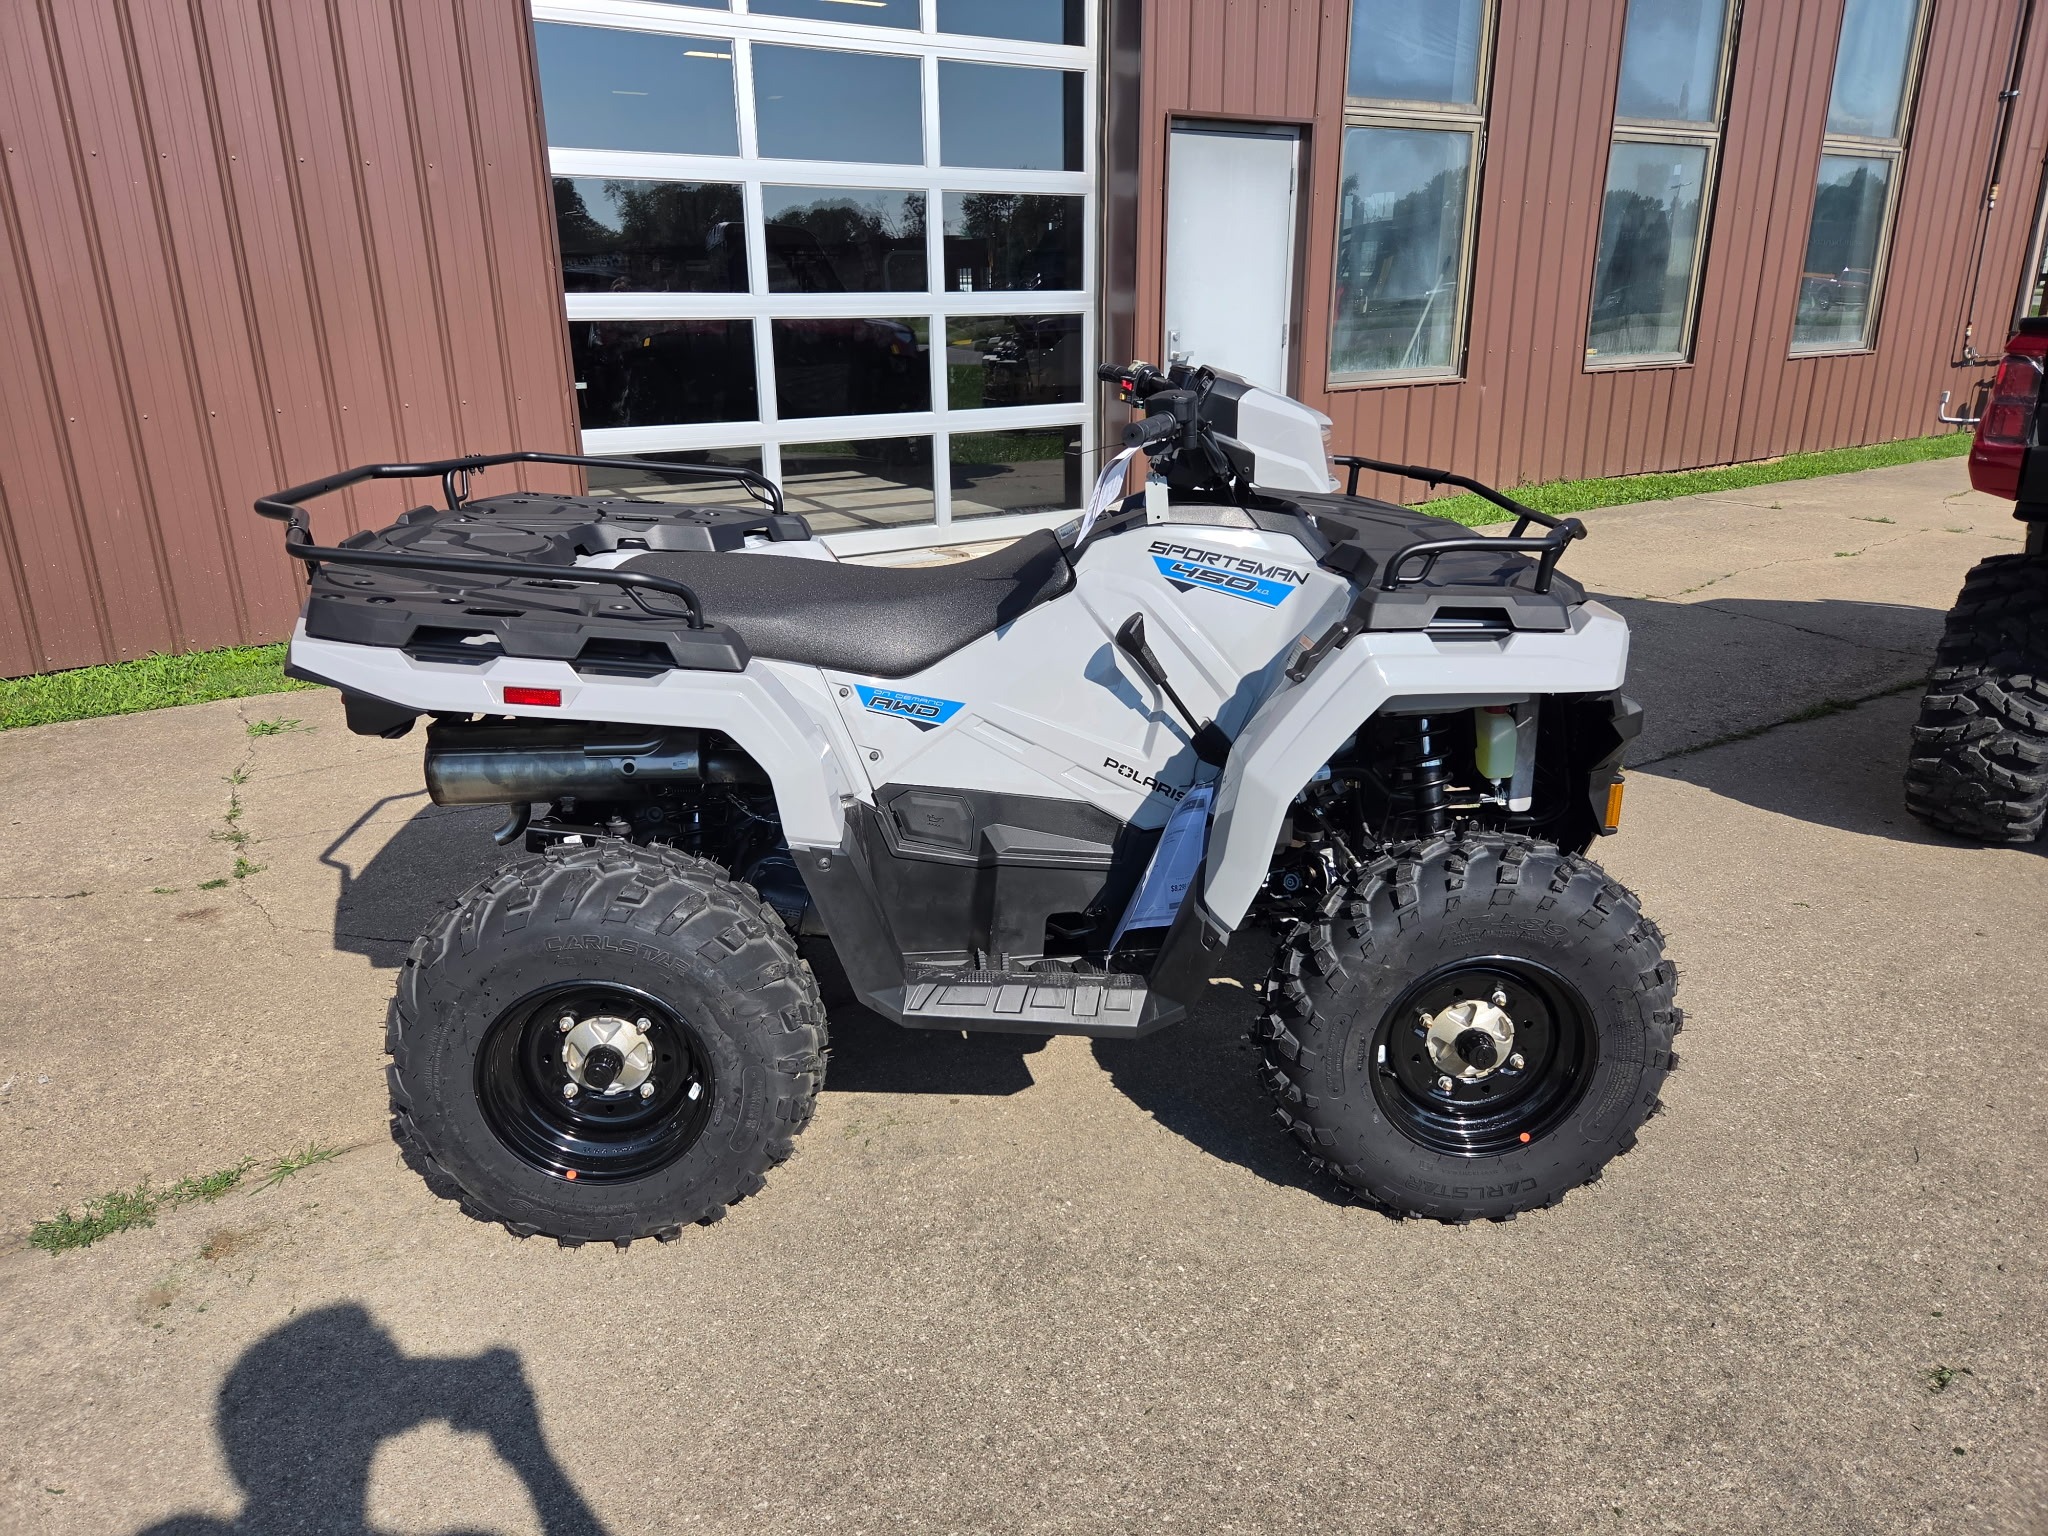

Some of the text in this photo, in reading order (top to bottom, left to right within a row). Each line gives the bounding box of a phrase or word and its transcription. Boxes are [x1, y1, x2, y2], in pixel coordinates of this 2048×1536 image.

[1148, 541, 1310, 585] SPORTSMAN
[1170, 562, 1259, 593] 450
[868, 696, 941, 717] AWD
[873, 689, 944, 707] ON DEMAND
[1103, 757, 1187, 802] POLARIS
[544, 934, 692, 977] CARLSTAR
[1404, 1174, 1538, 1200] CARLSTAR
